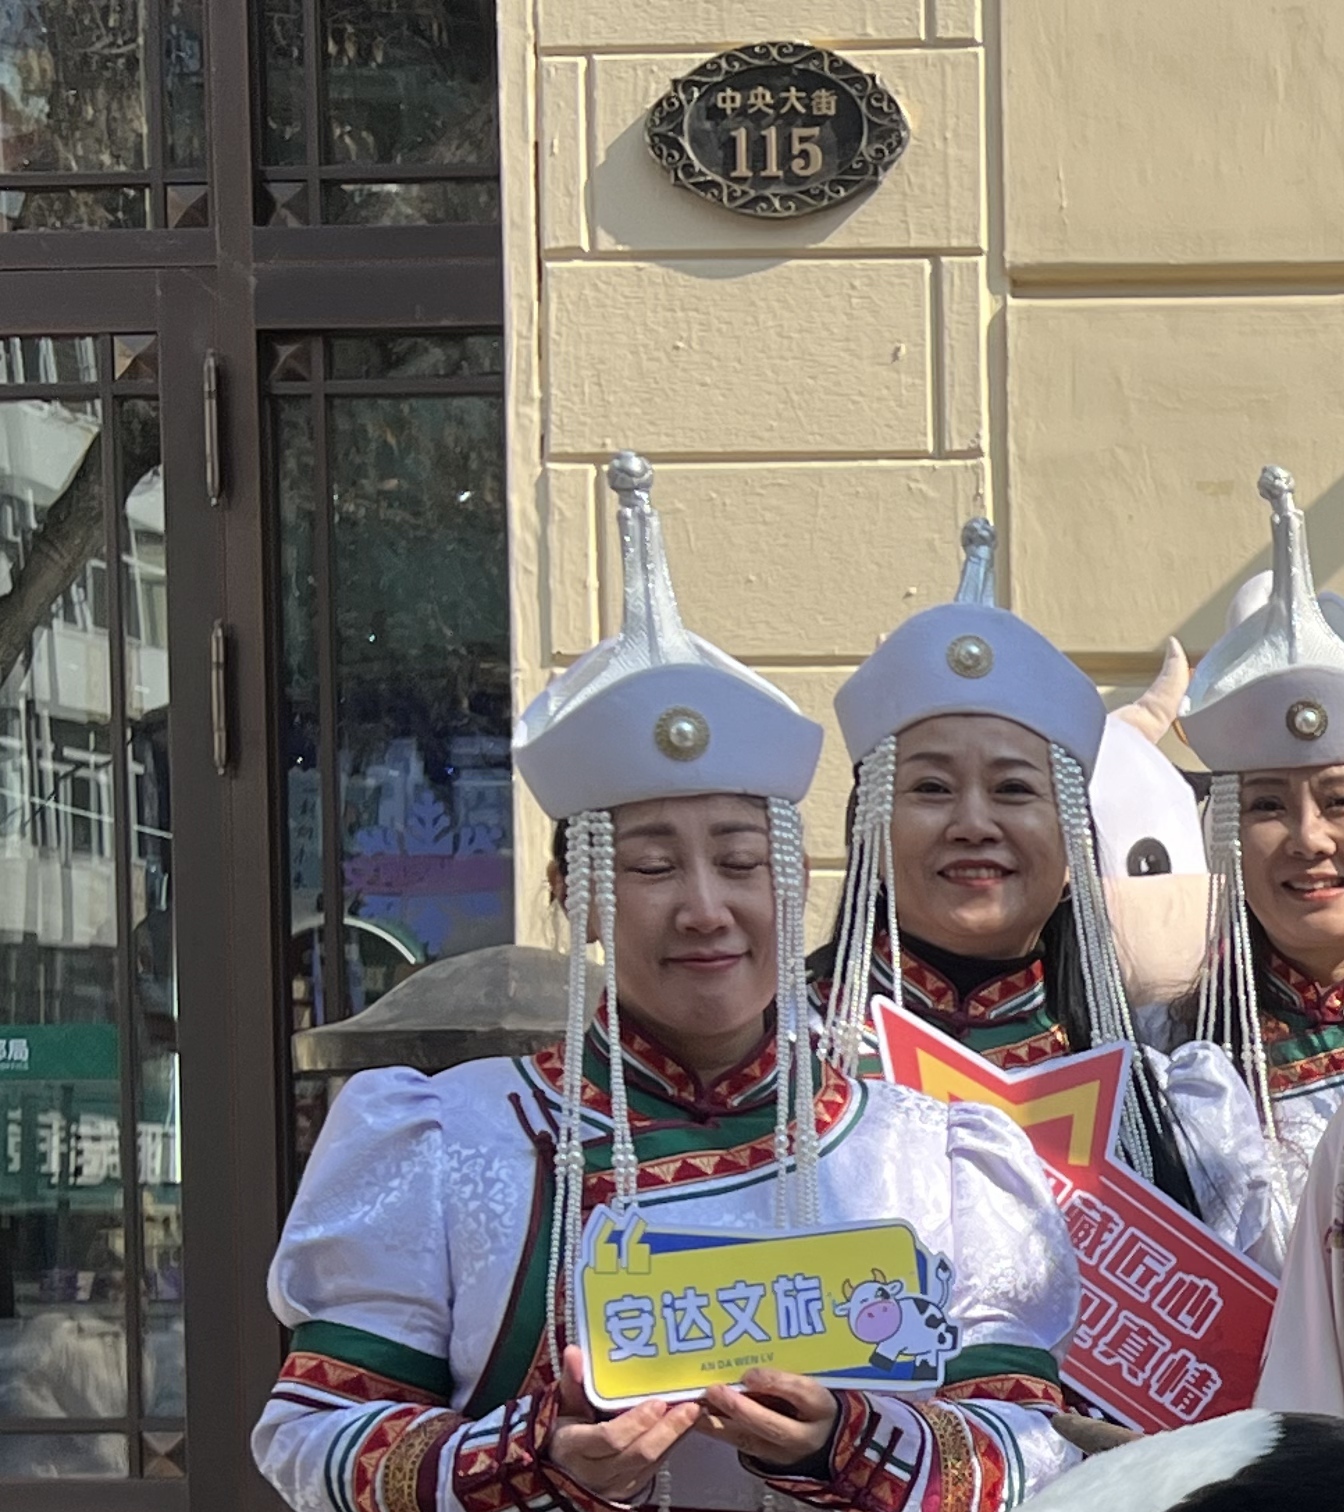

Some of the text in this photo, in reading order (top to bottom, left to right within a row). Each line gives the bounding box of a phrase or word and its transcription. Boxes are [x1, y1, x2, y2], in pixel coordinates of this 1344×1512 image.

[715, 86, 839, 117] 中央大街
[729, 125, 823, 179] 115
[1045, 1163, 1224, 1340] 藏匠心
[604, 1272, 827, 1362] 安达文旅
